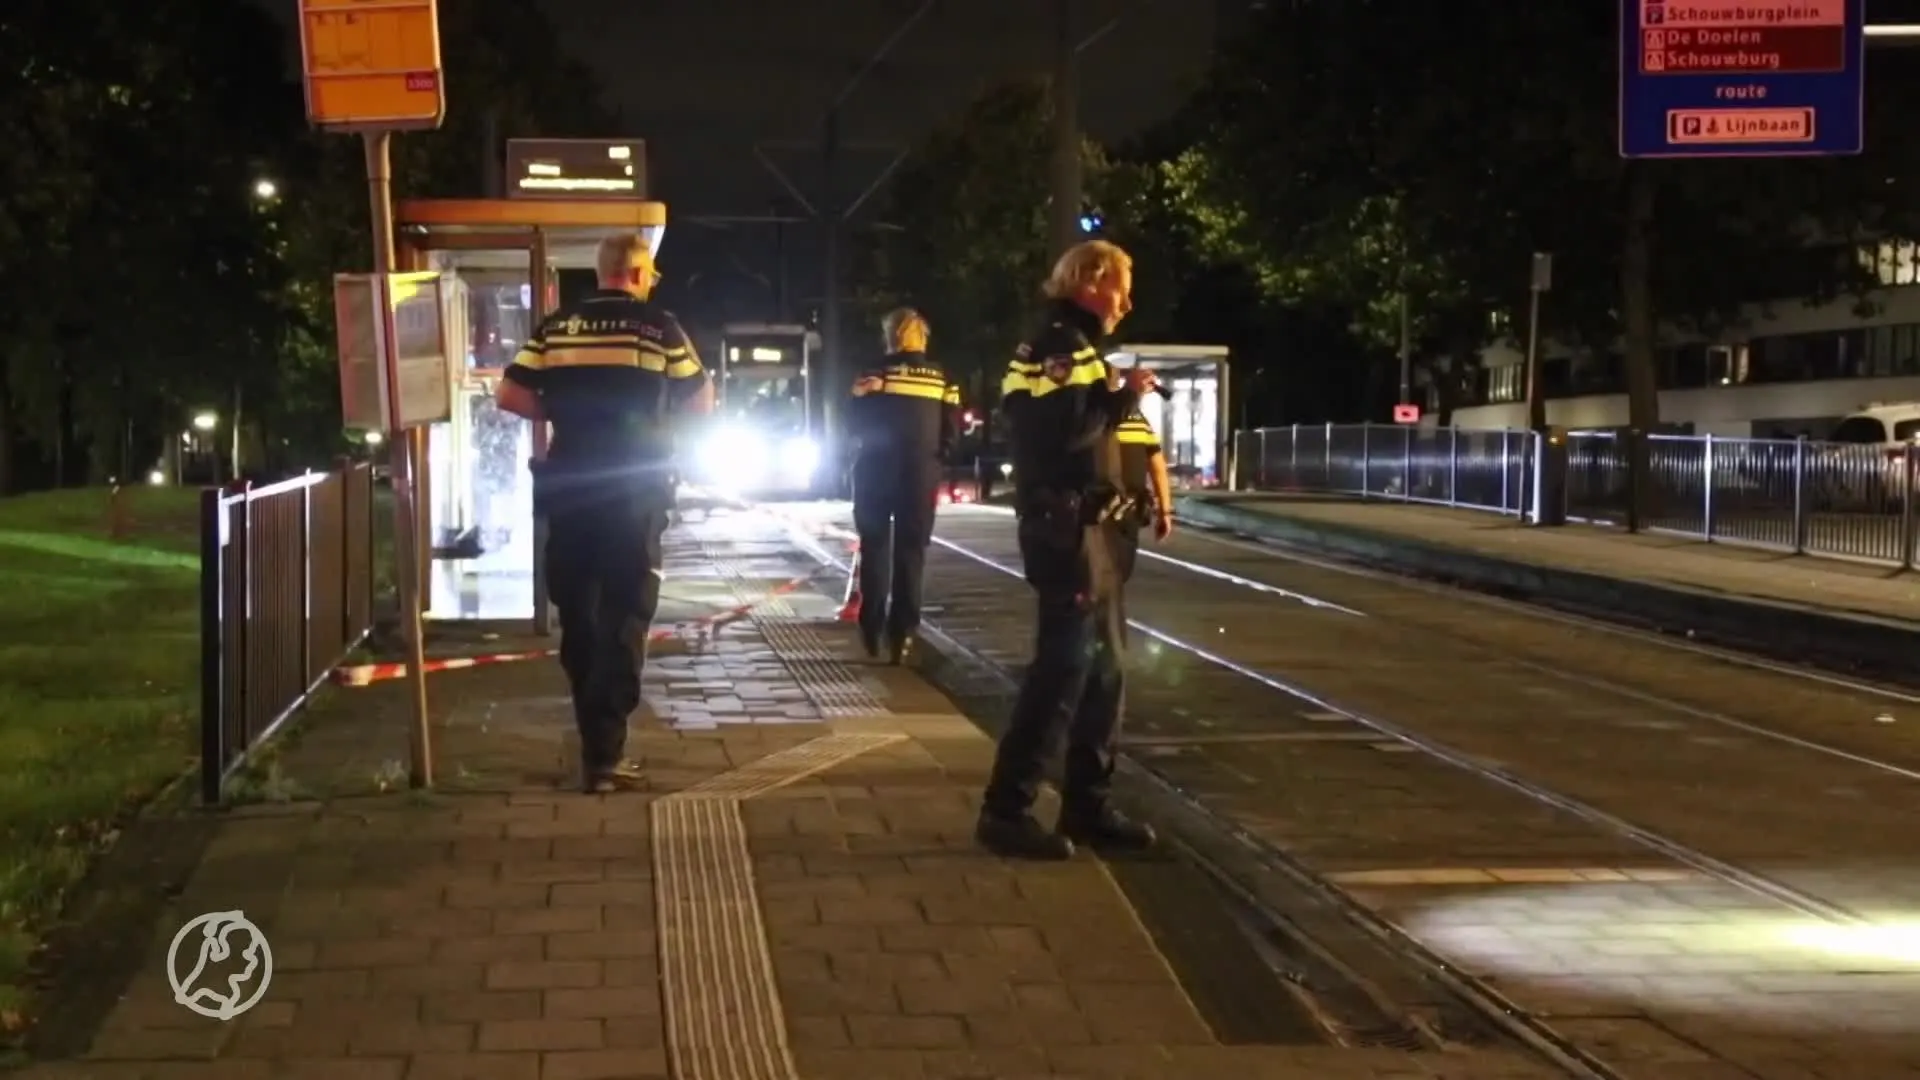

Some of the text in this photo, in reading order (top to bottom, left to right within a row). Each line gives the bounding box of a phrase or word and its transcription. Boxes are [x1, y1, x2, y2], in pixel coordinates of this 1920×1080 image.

[1668, 6, 1820, 21] Schouwburgplein
[1668, 29, 1761, 44] De Doelen
[1668, 50, 1780, 67] Schouwburg
[1715, 84, 1767, 98] route
[1726, 116, 1800, 135] Lijnbaan
